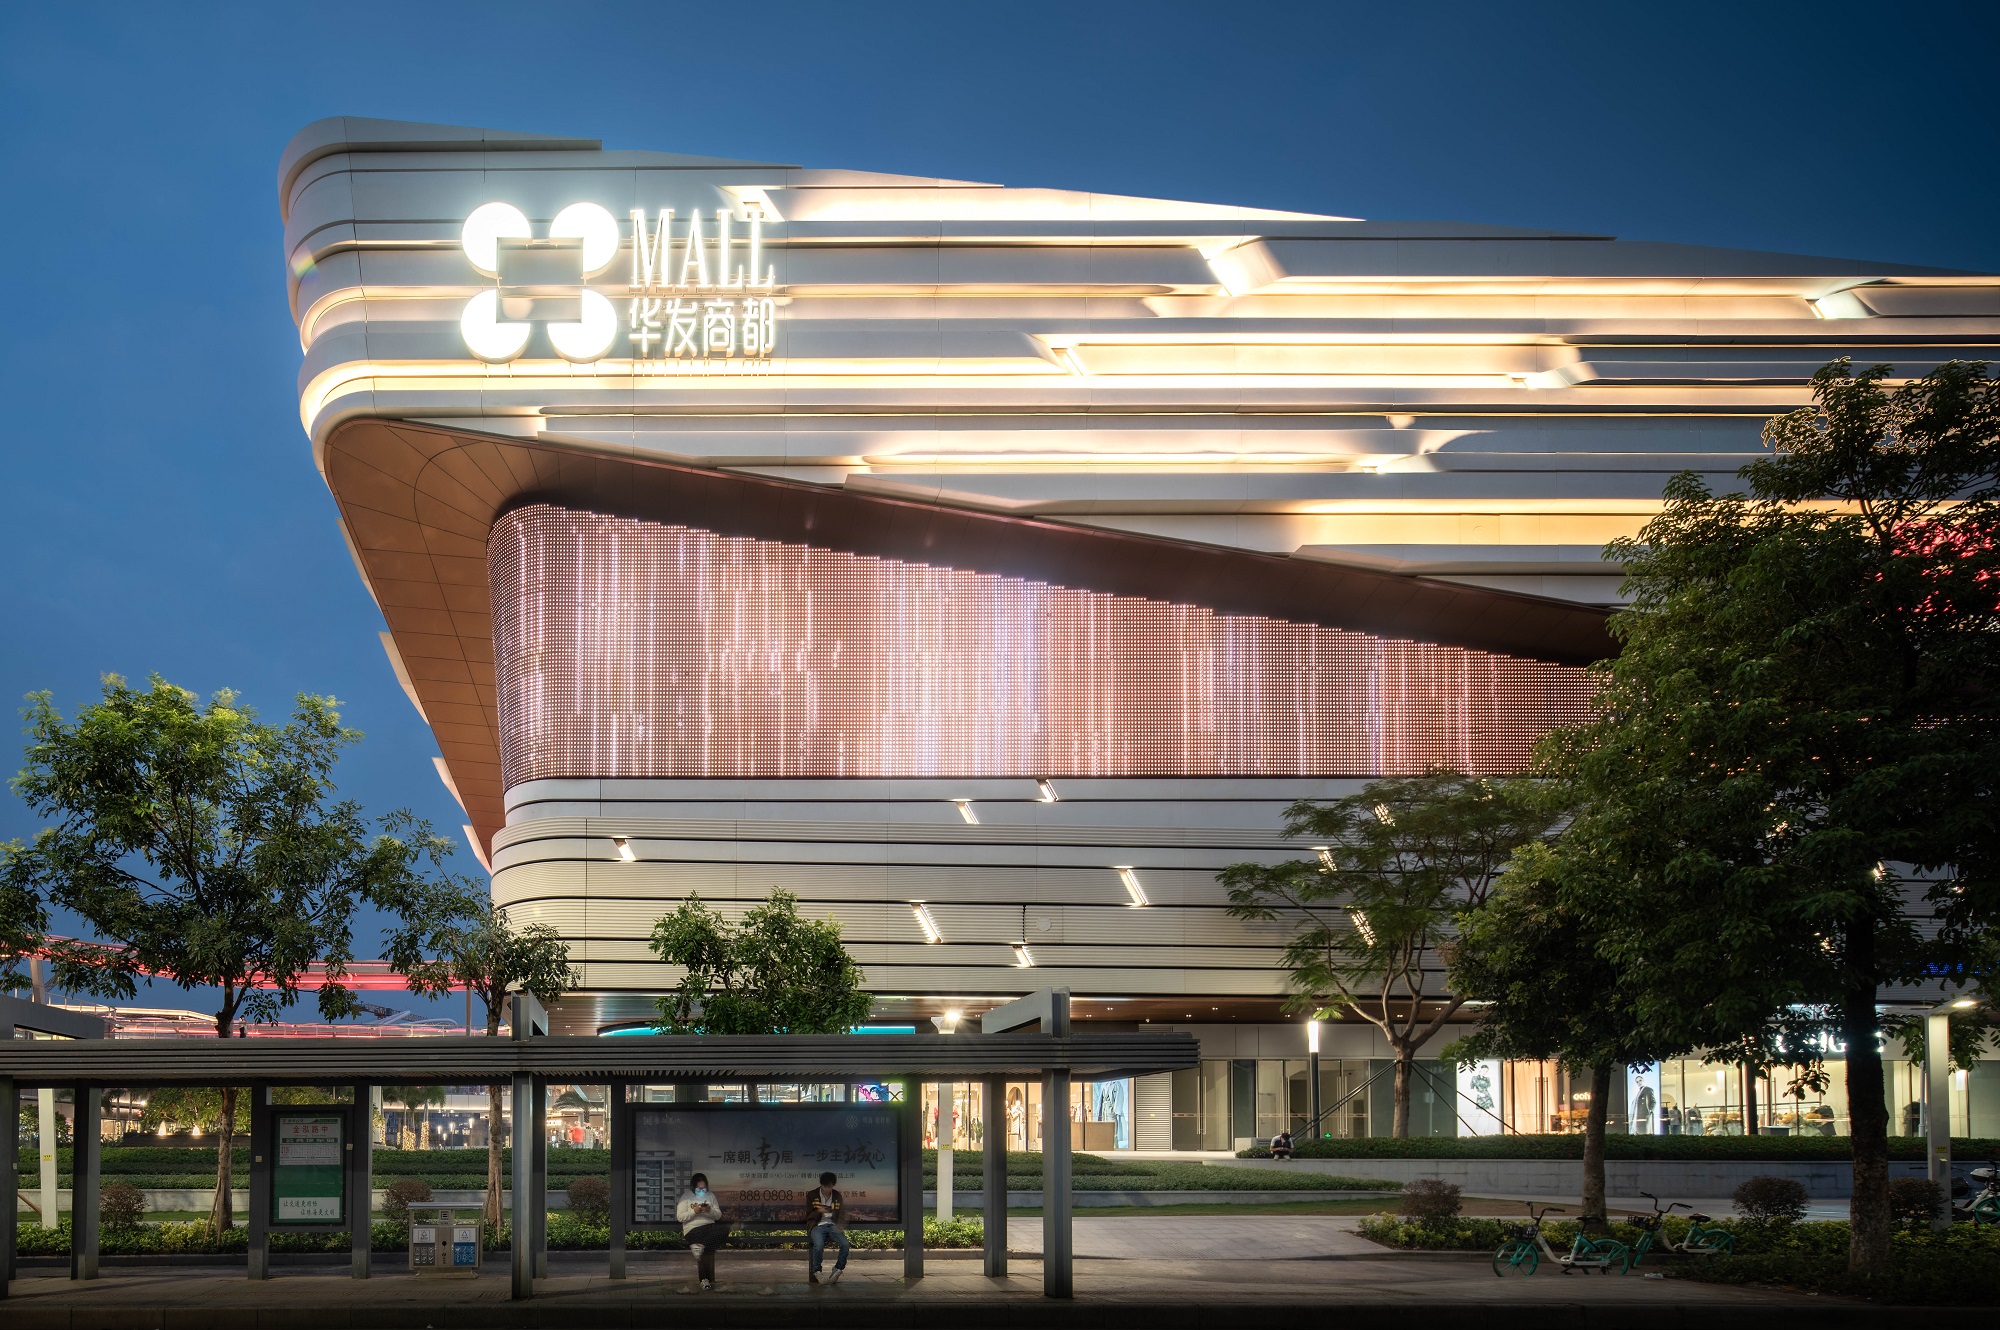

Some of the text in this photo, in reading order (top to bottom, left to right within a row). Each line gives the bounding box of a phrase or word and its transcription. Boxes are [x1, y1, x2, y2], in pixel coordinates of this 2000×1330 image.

[630, 208, 775, 289] MALL
[629, 298, 775, 353] 华发商都
[293, 1125, 328, 1134] 金泓路中
[739, 1190, 794, 1201] 888 0808
